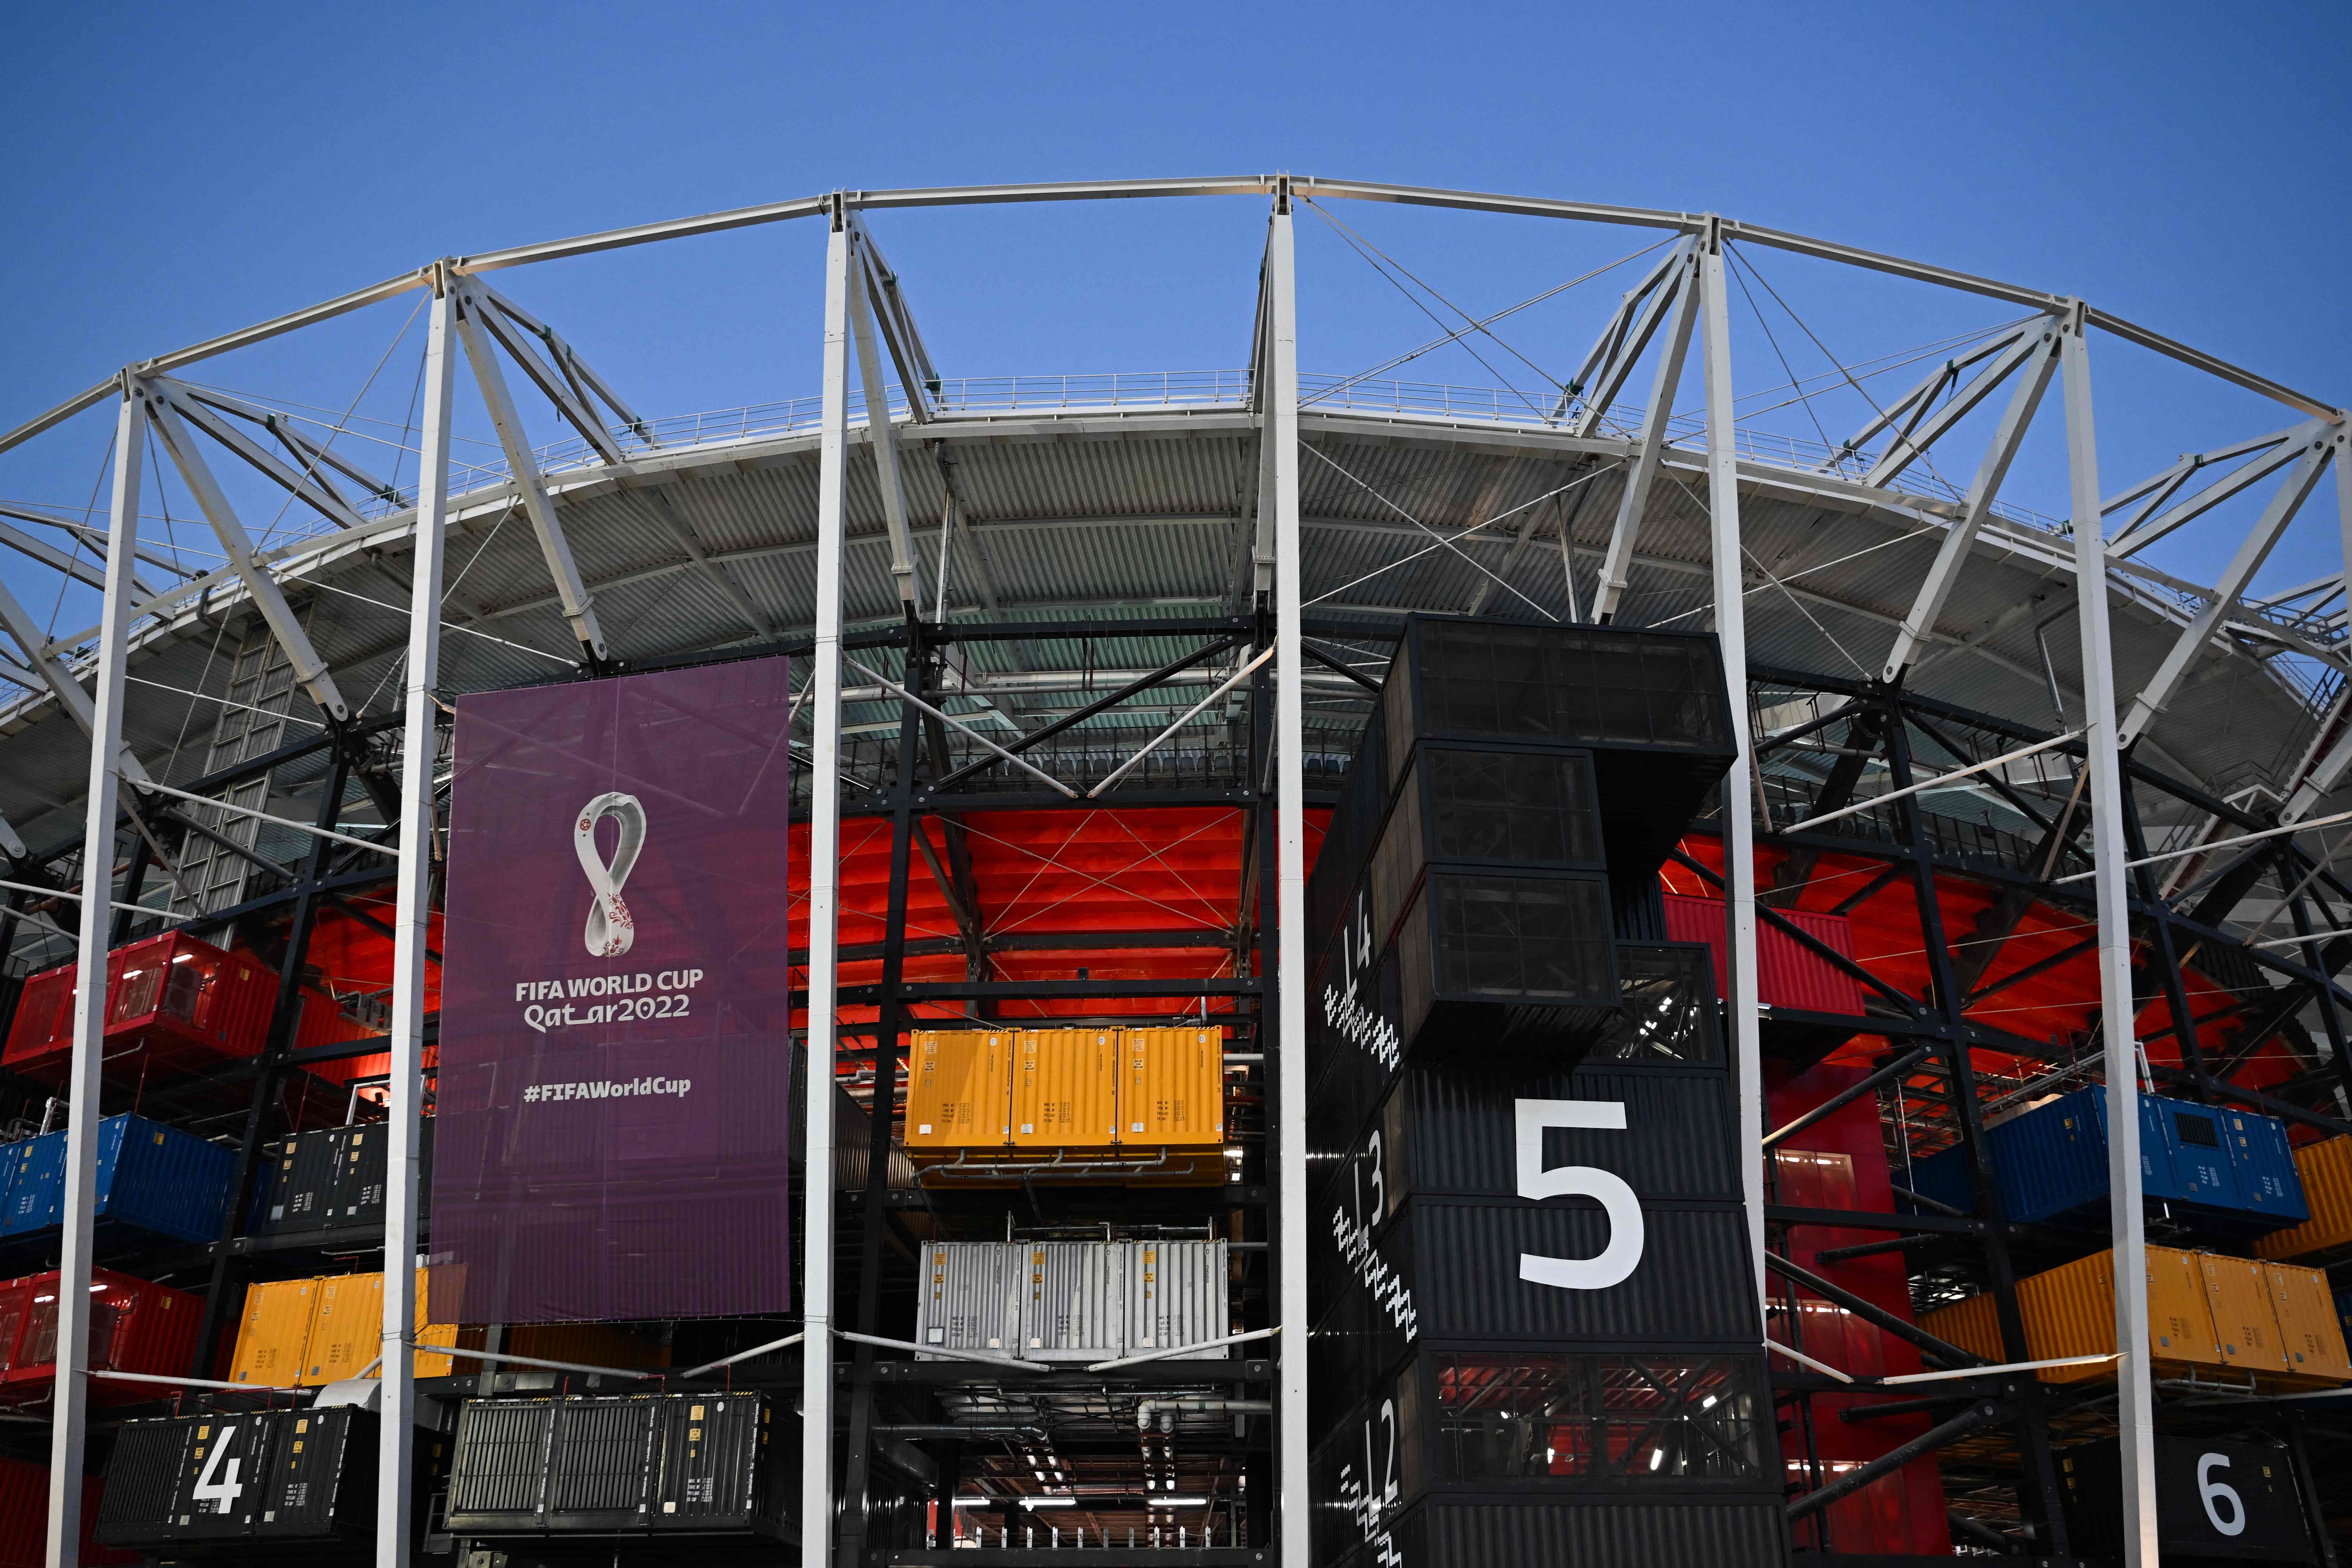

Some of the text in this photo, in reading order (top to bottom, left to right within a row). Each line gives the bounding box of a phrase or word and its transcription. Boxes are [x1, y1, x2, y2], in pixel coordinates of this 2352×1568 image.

[516, 969, 703, 1001] FIFA WORLD CUP
[1344, 890, 1370, 1006] L4
[524, 1077, 691, 1102] #FIFAWorldCup
[1355, 1130, 1383, 1248] L3
[1515, 1099, 1644, 1290] 5
[192, 1426, 242, 1514] 4
[1366, 1399, 1397, 1519] L2
[2197, 1453, 2245, 1536] 6
